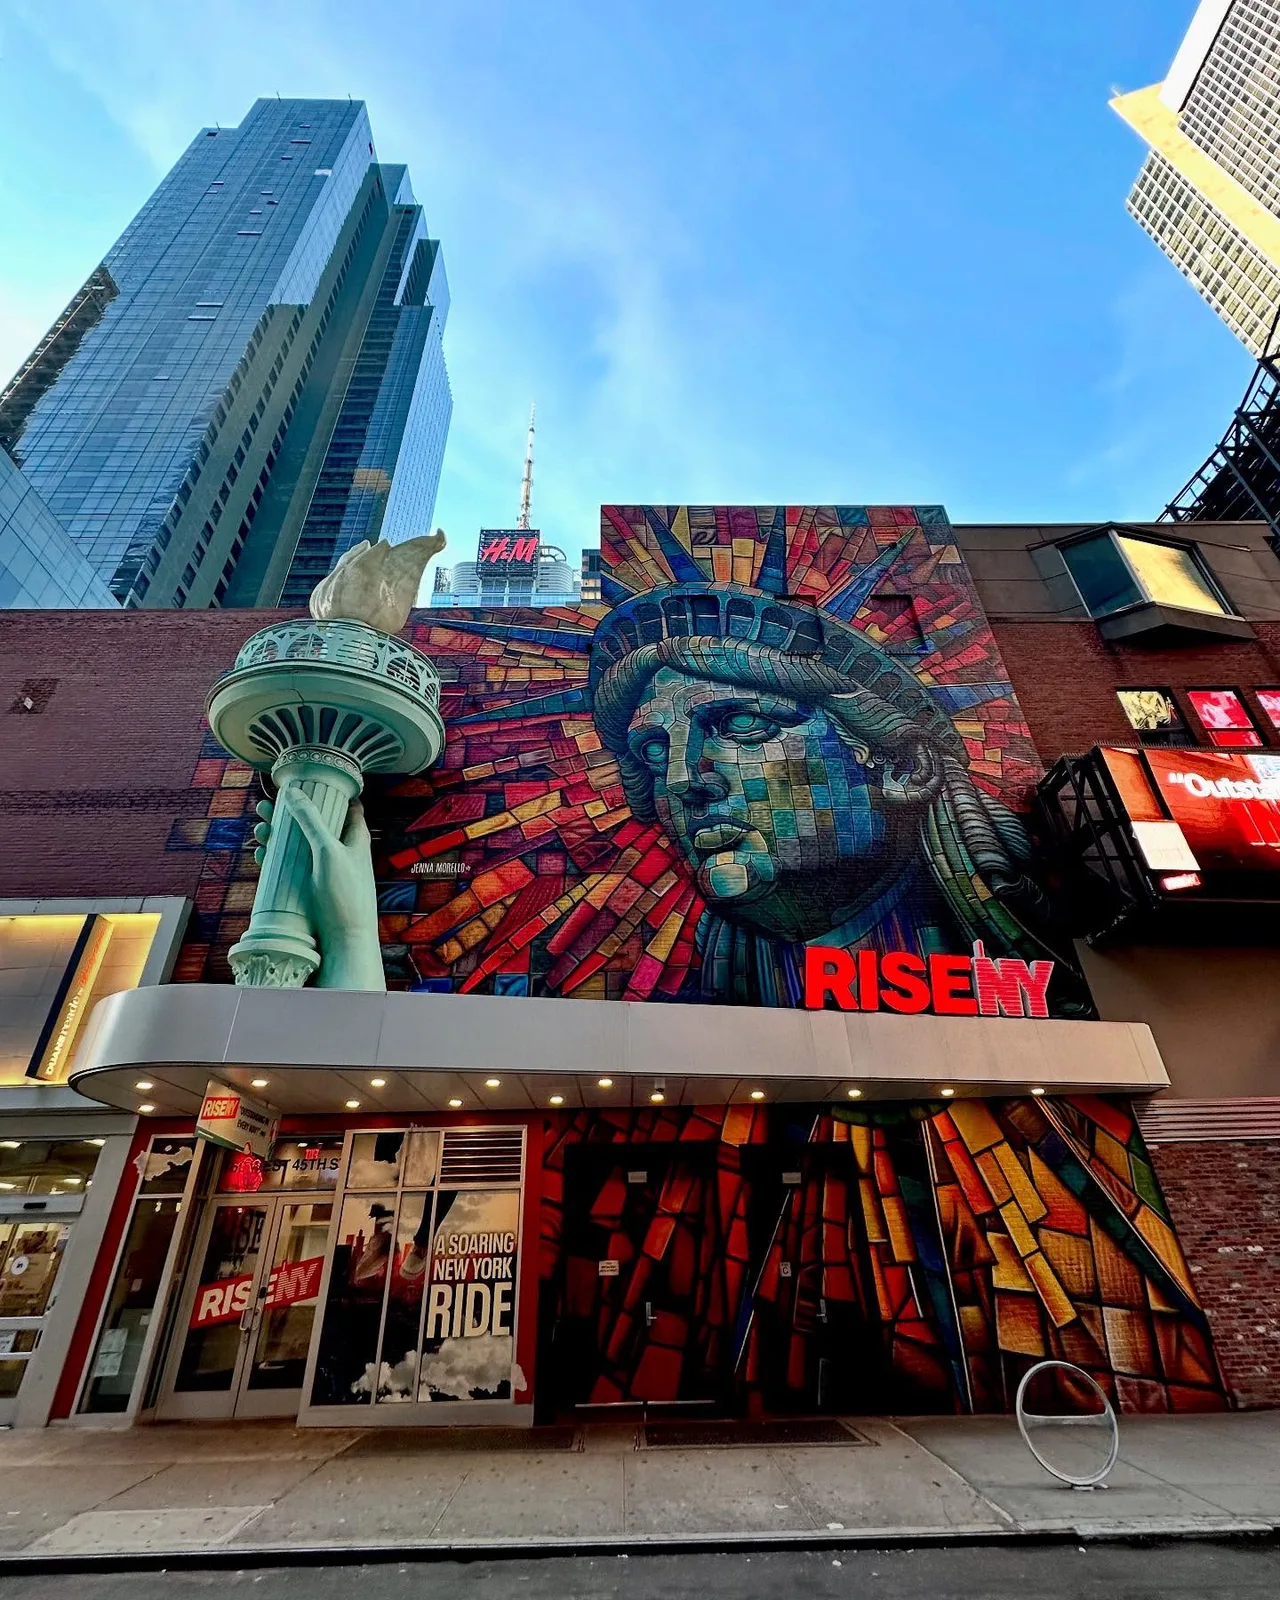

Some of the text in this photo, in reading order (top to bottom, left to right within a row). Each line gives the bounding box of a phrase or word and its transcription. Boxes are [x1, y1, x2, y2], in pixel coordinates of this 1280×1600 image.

[480, 536, 538, 563] H&M
[411, 862, 465, 874] JENNA MORELLO
[292, 1158, 328, 1171] 45TH
[435, 1232, 514, 1256] A SOARING
[433, 1256, 513, 1281] NEW YORK
[426, 1281, 513, 1339] RIDE
